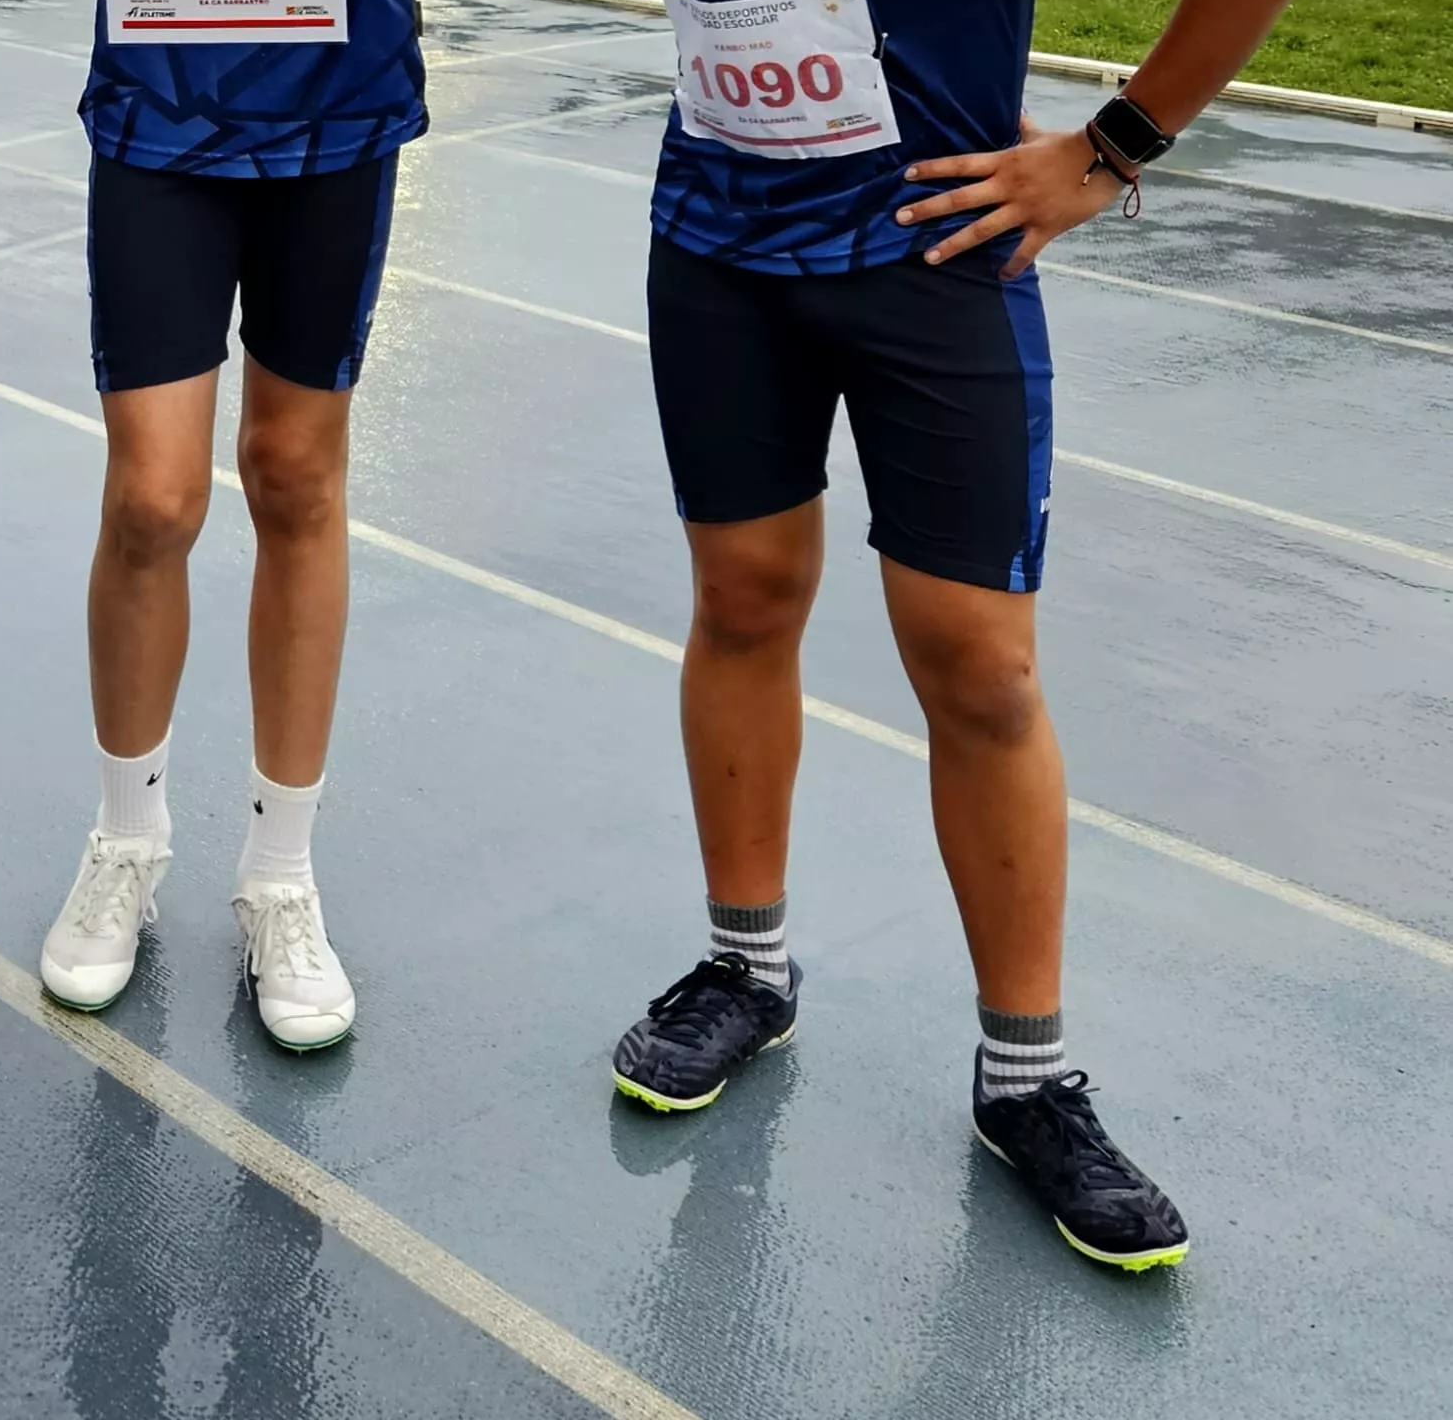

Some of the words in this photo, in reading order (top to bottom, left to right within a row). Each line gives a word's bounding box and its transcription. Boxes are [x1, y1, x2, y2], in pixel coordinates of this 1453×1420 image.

[718, 0, 796, 20] DEPORTIVOS
[724, 14, 779, 29] ESCOLAR
[691, 54, 843, 108] 1090
